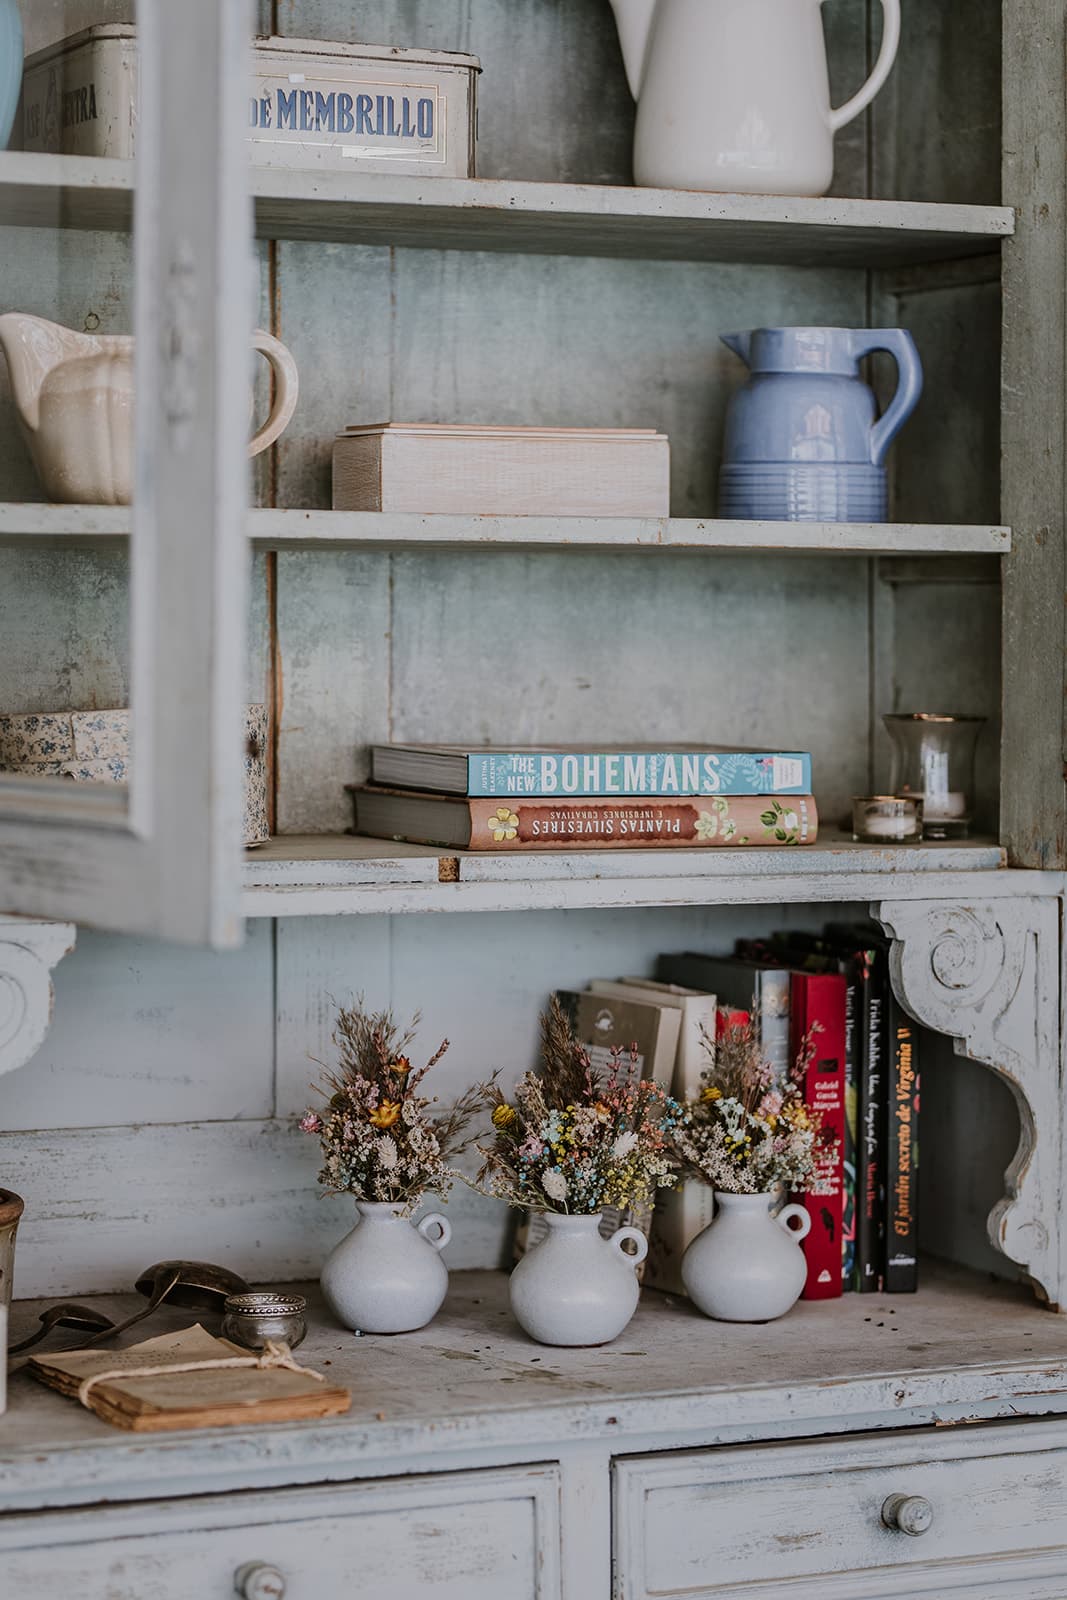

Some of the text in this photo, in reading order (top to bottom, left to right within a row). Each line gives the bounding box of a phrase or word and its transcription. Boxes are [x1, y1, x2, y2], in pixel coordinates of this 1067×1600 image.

[276, 88, 435, 139] MEMBRILLO
[509, 757, 535, 773] THE
[541, 754, 721, 793] BOHEMIANS
[507, 775, 535, 792] NEW
[550, 810, 663, 820] E INFUSIONES CURATIVAS
[532, 818, 681, 835] PLANTAS SILVESTRES
[895, 1043, 915, 1102] Virginia
[895, 1104, 912, 1123] de
[895, 1123, 912, 1173] secreto
[894, 1175, 913, 1222] jardín
[894, 1220, 910, 1237] El
